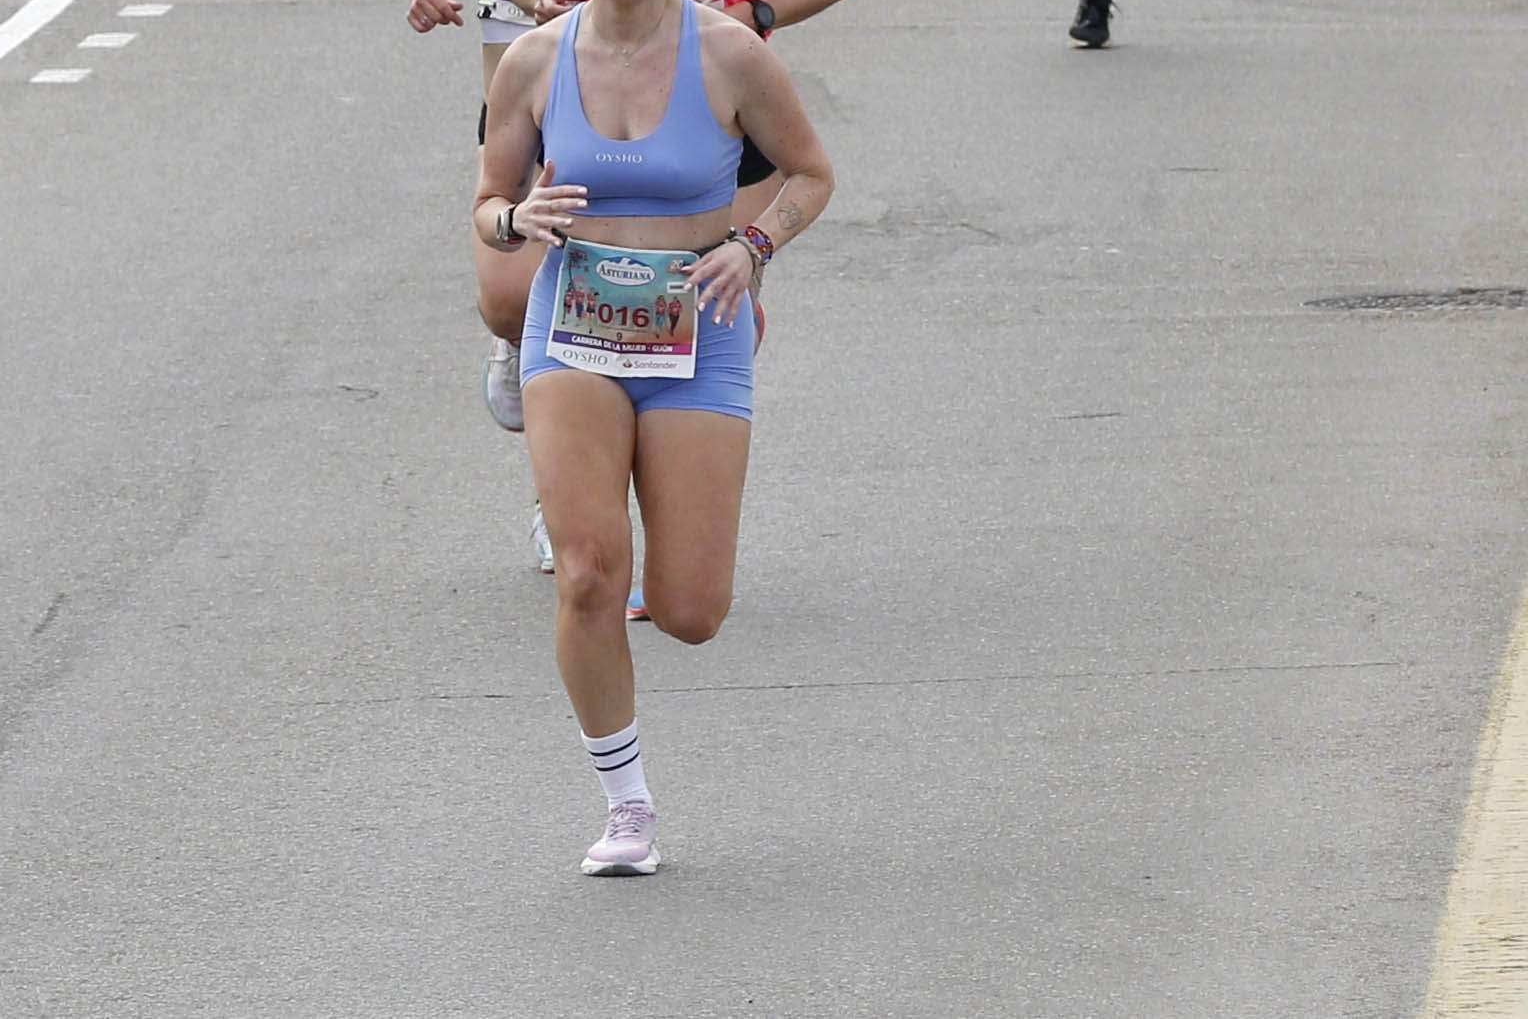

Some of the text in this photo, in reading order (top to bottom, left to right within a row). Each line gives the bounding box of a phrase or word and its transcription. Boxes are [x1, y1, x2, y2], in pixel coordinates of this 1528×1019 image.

[595, 153, 643, 164] OYSHO
[600, 264, 652, 281] ASTURIANA
[597, 303, 650, 328] 016
[616, 332, 623, 342] 9
[562, 349, 608, 367] OYSHO
[633, 360, 678, 370] Santander
